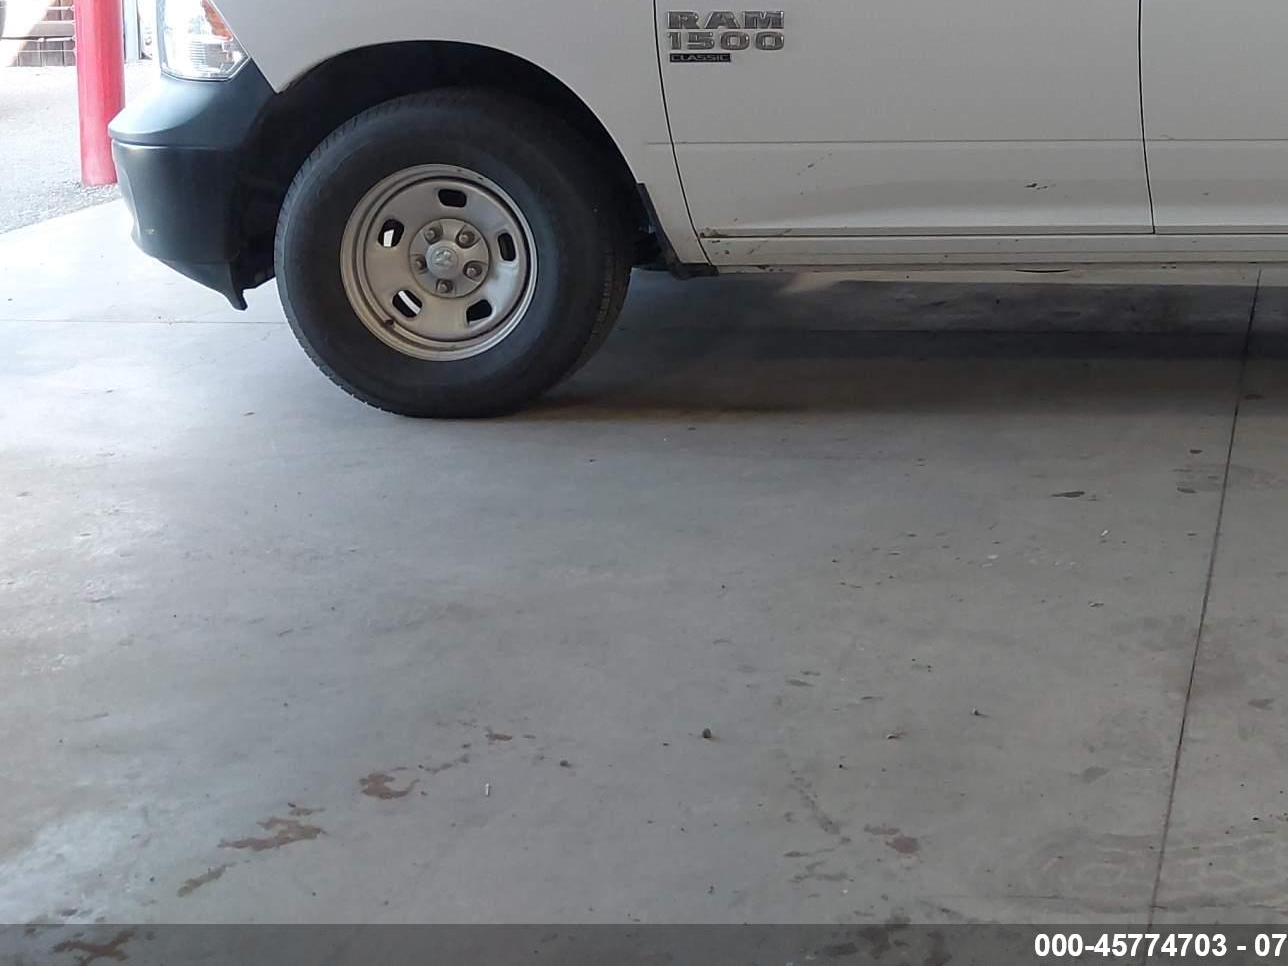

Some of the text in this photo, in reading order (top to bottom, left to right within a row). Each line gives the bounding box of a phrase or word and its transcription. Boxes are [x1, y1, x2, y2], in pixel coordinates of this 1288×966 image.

[667, 10, 785, 29] RAM
[667, 31, 785, 50] 1500
[671, 54, 730, 62] CLASSIC
